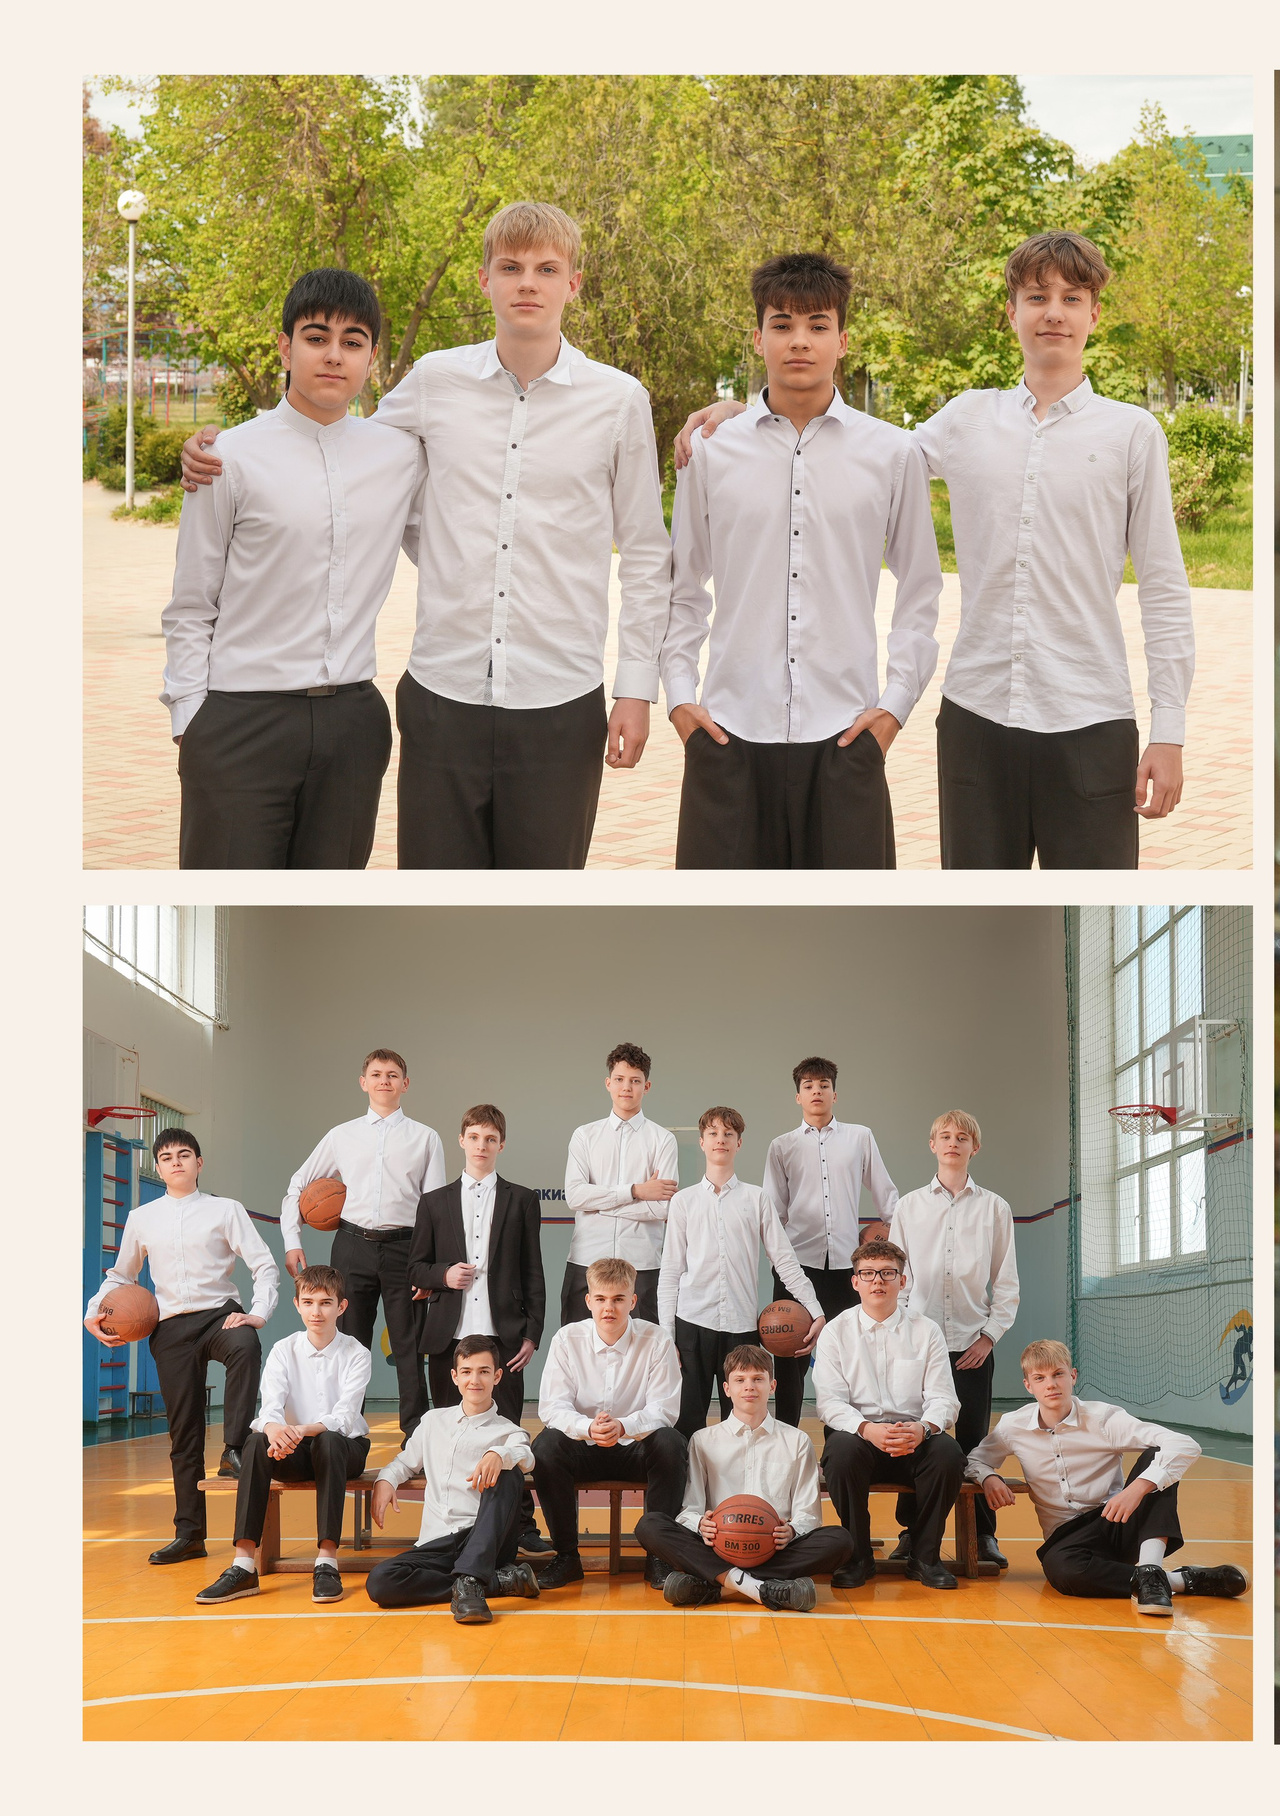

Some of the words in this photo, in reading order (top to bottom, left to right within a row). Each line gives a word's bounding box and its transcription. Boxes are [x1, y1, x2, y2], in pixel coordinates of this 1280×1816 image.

[760, 1323, 795, 1335] TORRES
[722, 1513, 764, 1526] TORRES
[724, 1540, 740, 1551] BM
[742, 1542, 761, 1552] 300
